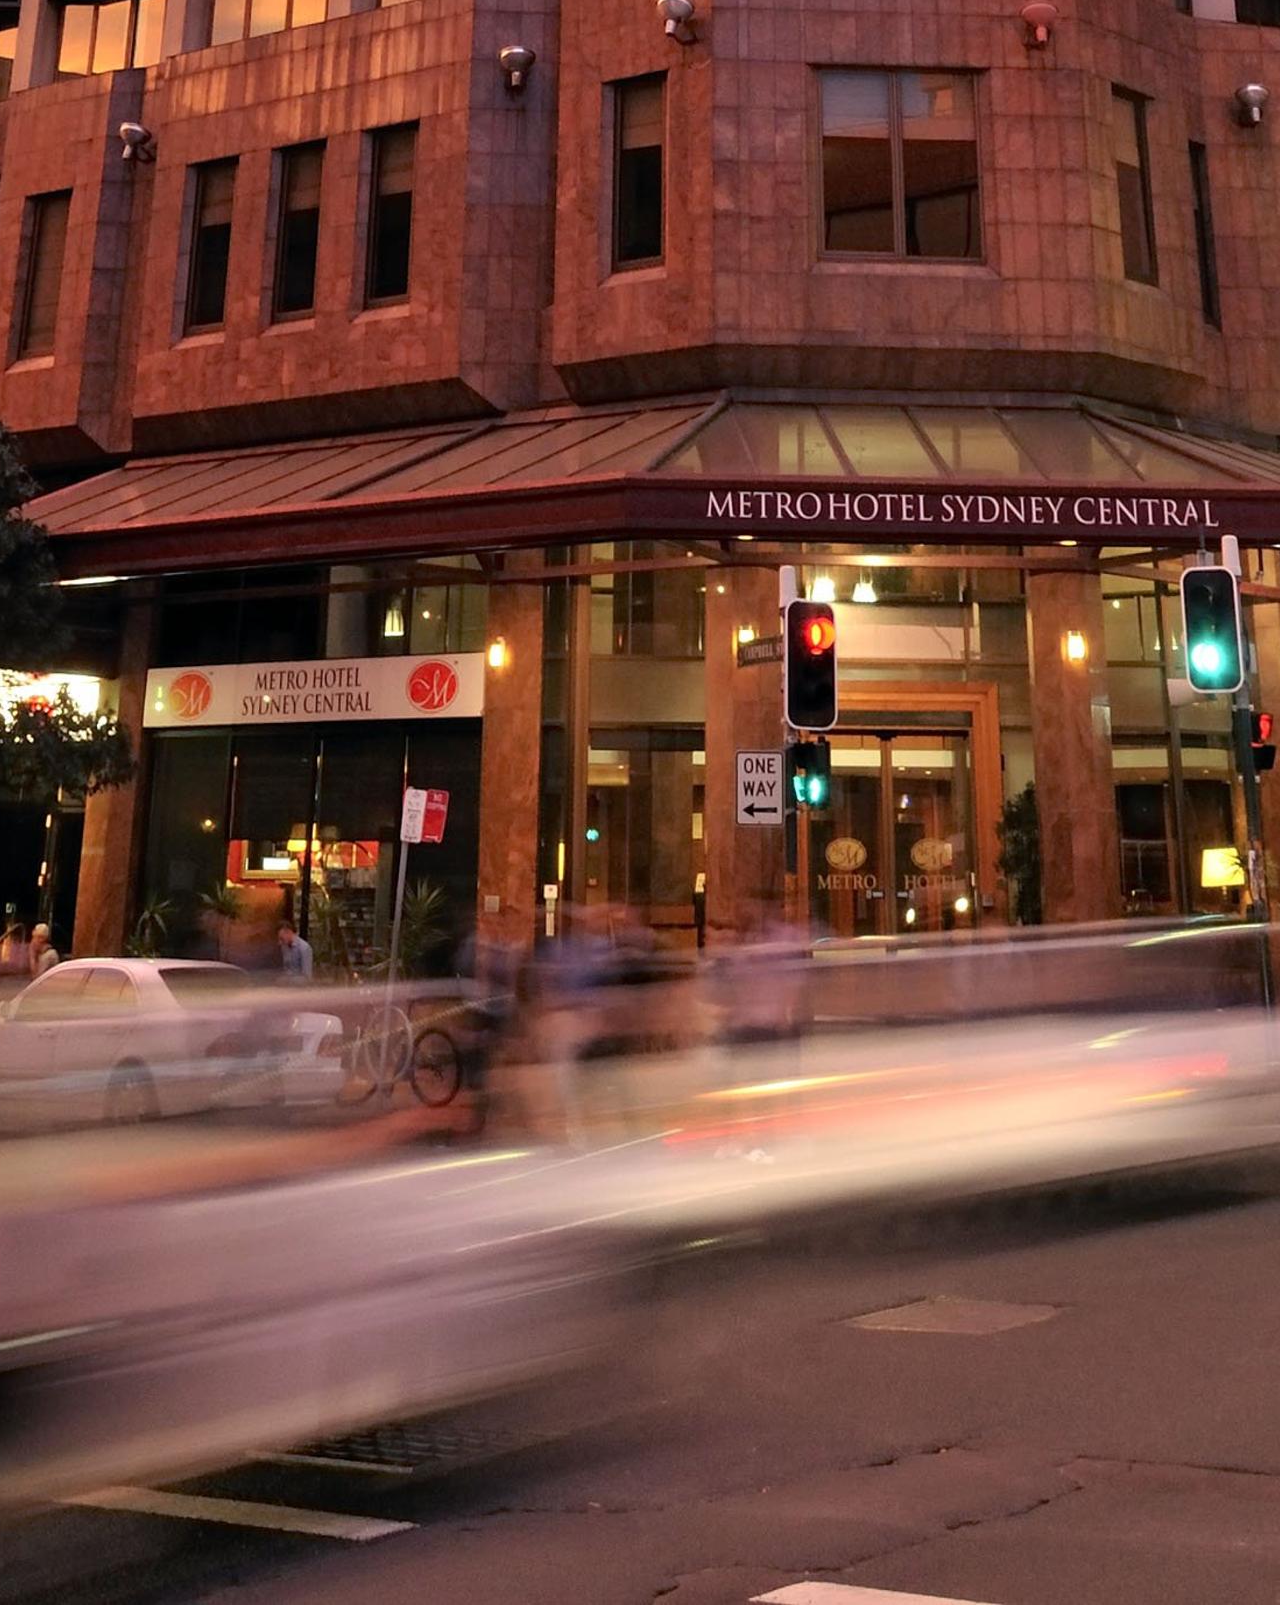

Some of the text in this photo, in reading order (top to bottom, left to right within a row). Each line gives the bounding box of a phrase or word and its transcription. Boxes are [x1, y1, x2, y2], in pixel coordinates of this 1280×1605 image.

[706, 490, 1219, 527] METRO HOTEL SYDNEY CENTRAL
[255, 667, 362, 691] METRO HOTEL
[241, 691, 372, 716] SYDNEY CENTRAL
[744, 758, 776, 774] ONE
[743, 780, 776, 797] WAY
[817, 874, 877, 890] METRO
